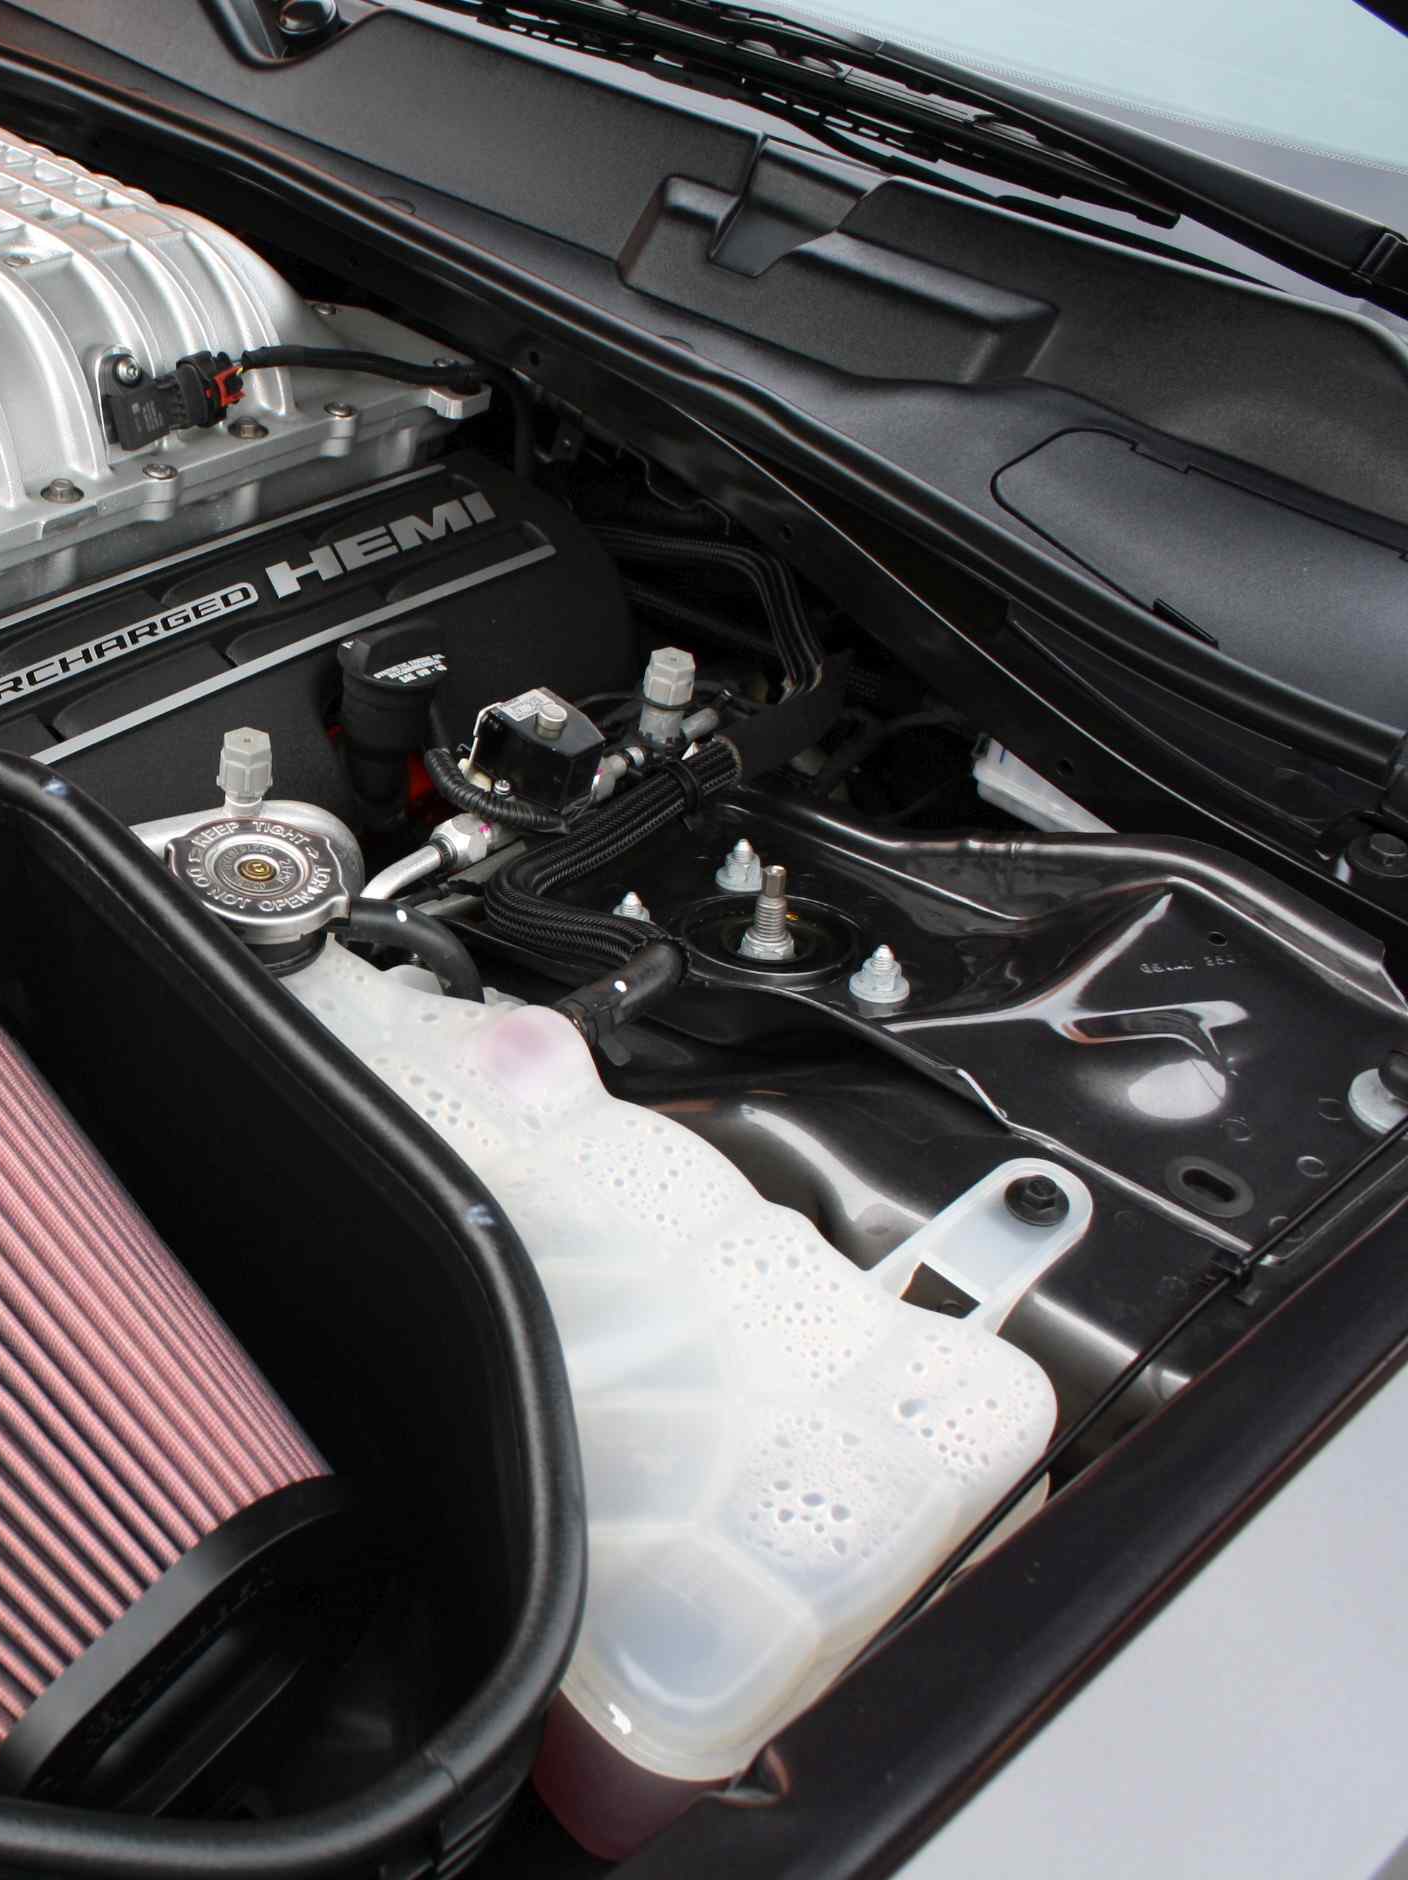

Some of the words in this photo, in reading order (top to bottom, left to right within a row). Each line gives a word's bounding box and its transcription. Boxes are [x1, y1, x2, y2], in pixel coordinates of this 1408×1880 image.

[264, 491, 496, 599] HEMI
[191, 821, 241, 848] KEEP
[252, 820, 310, 845] TIGHT
[185, 867, 211, 888] DO
[206, 886, 252, 910] NOT
[257, 890, 315, 913] OPEN
[307, 866, 332, 895] HOT
